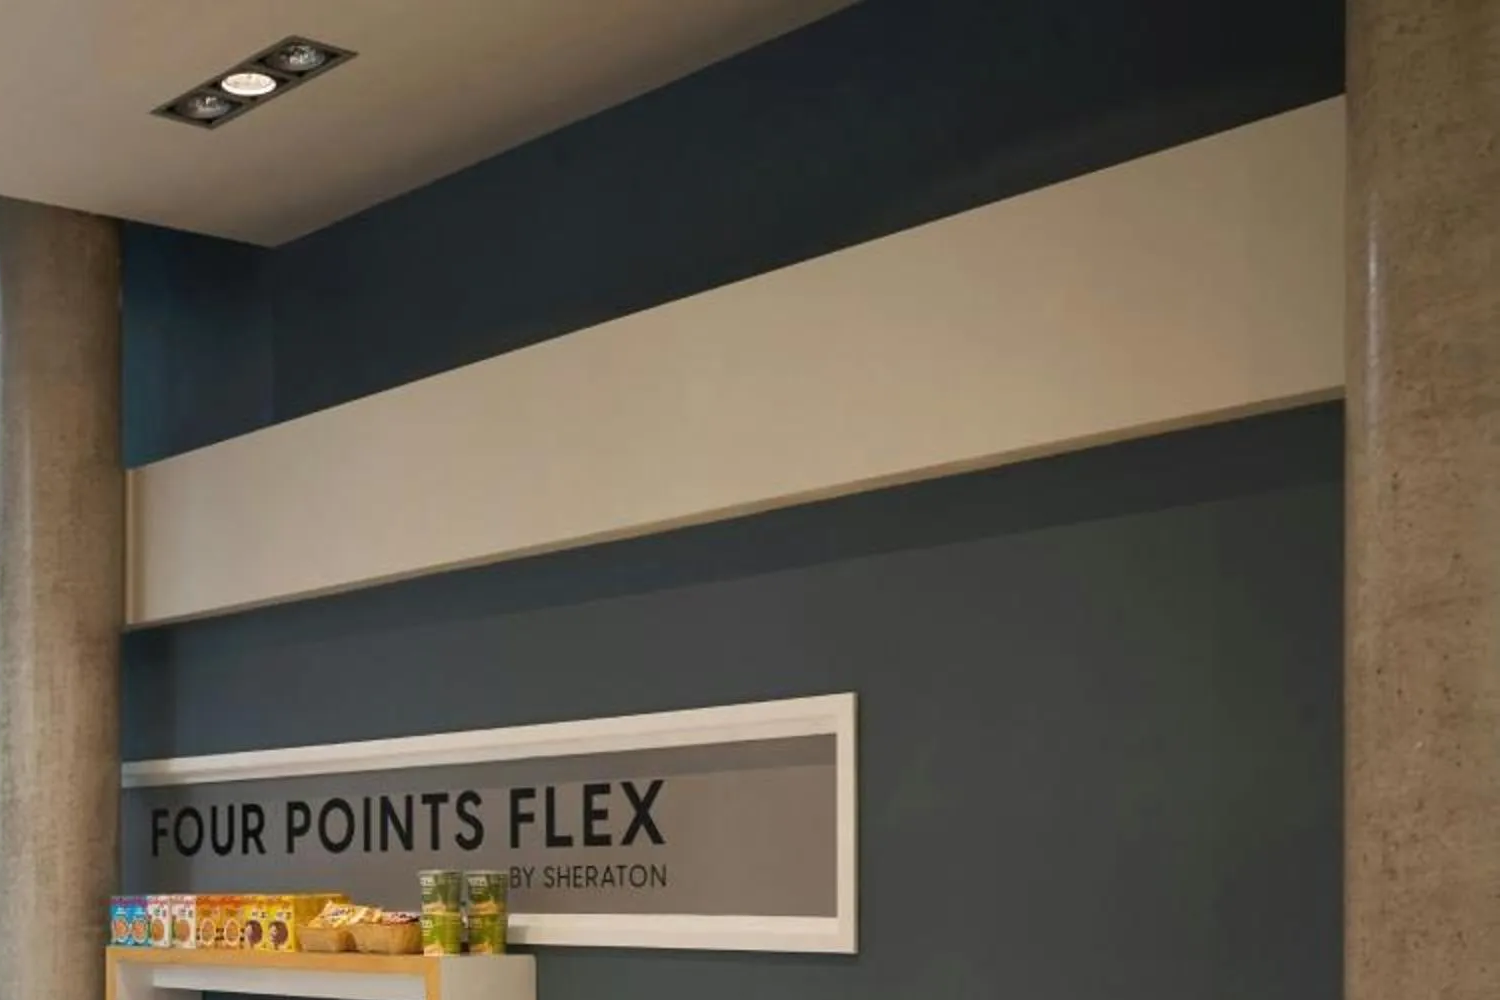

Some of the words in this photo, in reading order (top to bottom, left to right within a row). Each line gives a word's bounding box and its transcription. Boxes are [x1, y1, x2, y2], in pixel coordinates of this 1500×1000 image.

[151, 803, 266, 857] FOUR
[286, 790, 484, 855] POINTS
[509, 779, 666, 849] FLEX
[510, 865, 535, 889] BY
[543, 864, 668, 888] SHERATON
